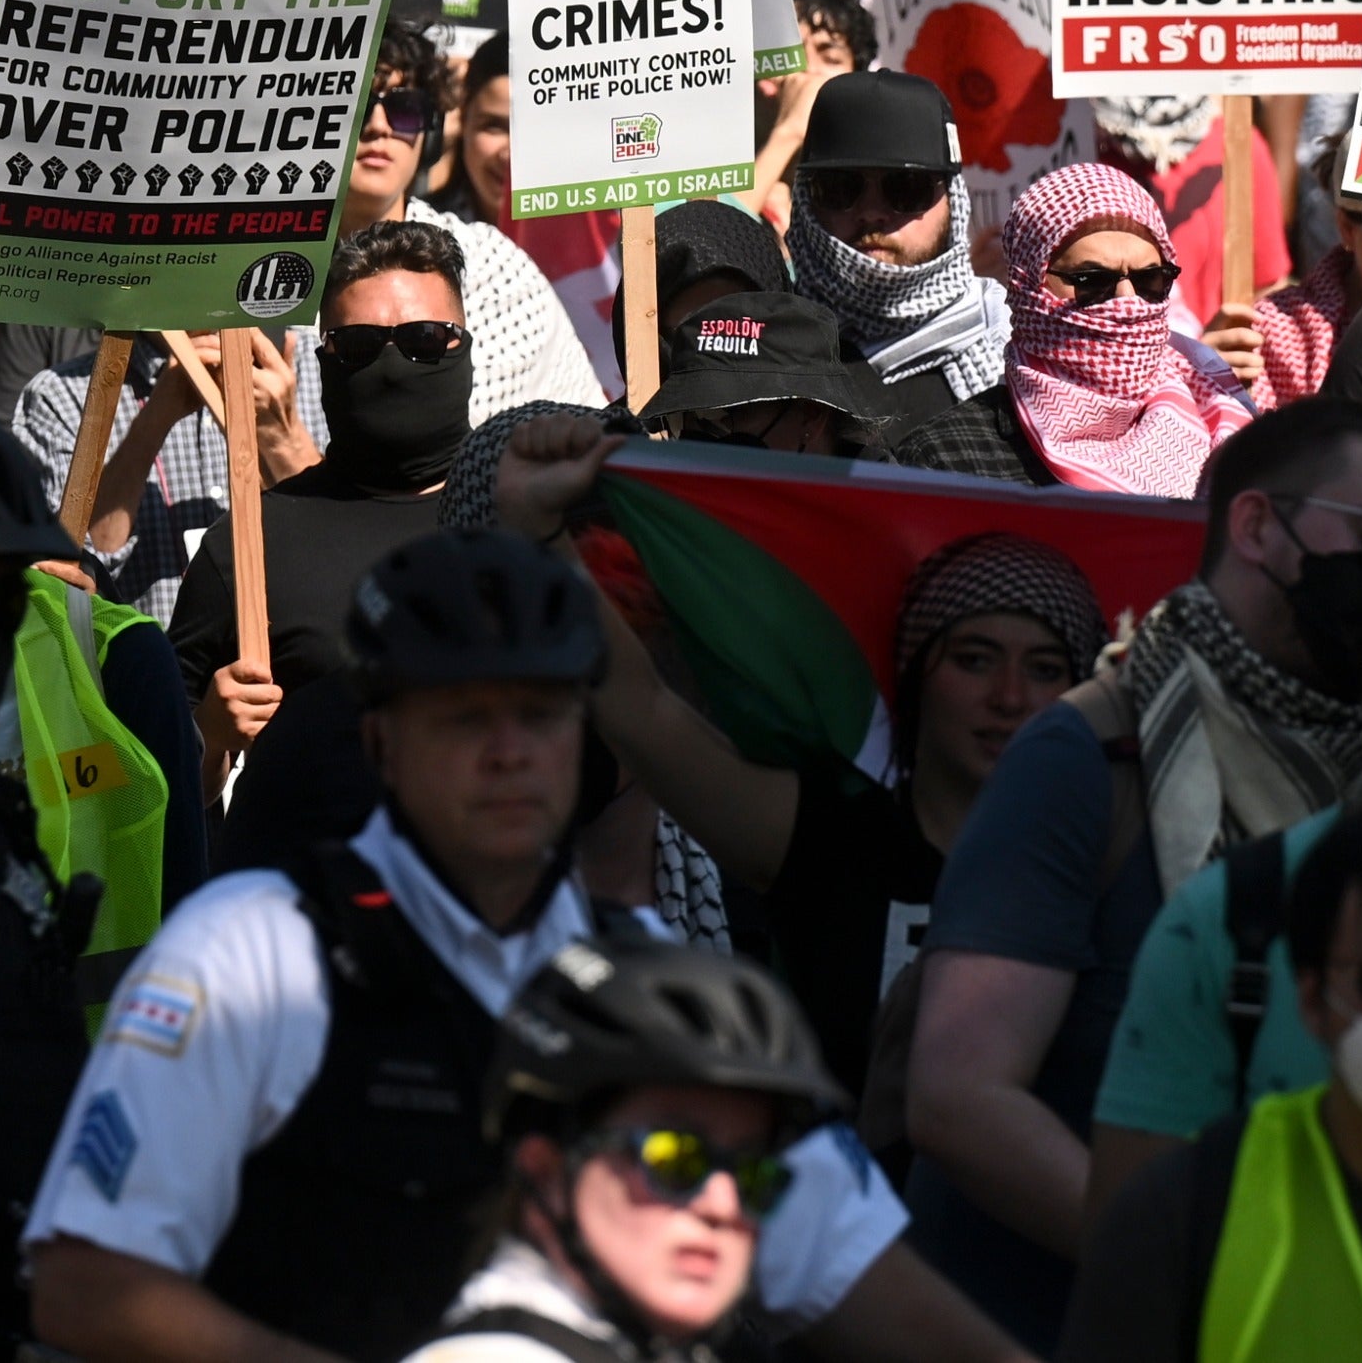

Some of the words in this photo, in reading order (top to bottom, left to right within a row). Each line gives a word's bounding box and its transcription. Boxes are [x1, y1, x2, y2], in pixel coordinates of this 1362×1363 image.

[1236, 23, 1299, 43] Freedom
[1301, 22, 1338, 41] Road
[1236, 42, 1299, 62] Socialist
[527, 57, 641, 86] COMMUNITY
[648, 48, 736, 73] CONTROL
[62, 65, 248, 101] COMMUNITY
[256, 70, 357, 99] POWER
[533, 86, 559, 106] OF
[565, 80, 600, 102] THE
[607, 75, 674, 98] POLICE
[680, 68, 732, 90] NOW!
[151, 104, 350, 154] POLICE
[616, 130, 646, 145] DNC
[615, 142, 656, 158] 2024
[520, 189, 561, 213] END
[566, 187, 598, 209] U.S
[603, 181, 638, 204] AID
[645, 178, 671, 200] TO
[677, 169, 749, 196] ISRAEL!
[26, 205, 115, 234] POWER
[127, 213, 161, 236] TO
[171, 213, 217, 237] THE
[228, 209, 327, 234] PEOPLE
[26, 246, 94, 263] Alliance
[97, 251, 161, 267] Against
[165, 252, 218, 265] Racist
[56, 270, 152, 287] Repression
[697, 335, 758, 356] TEQUILA
